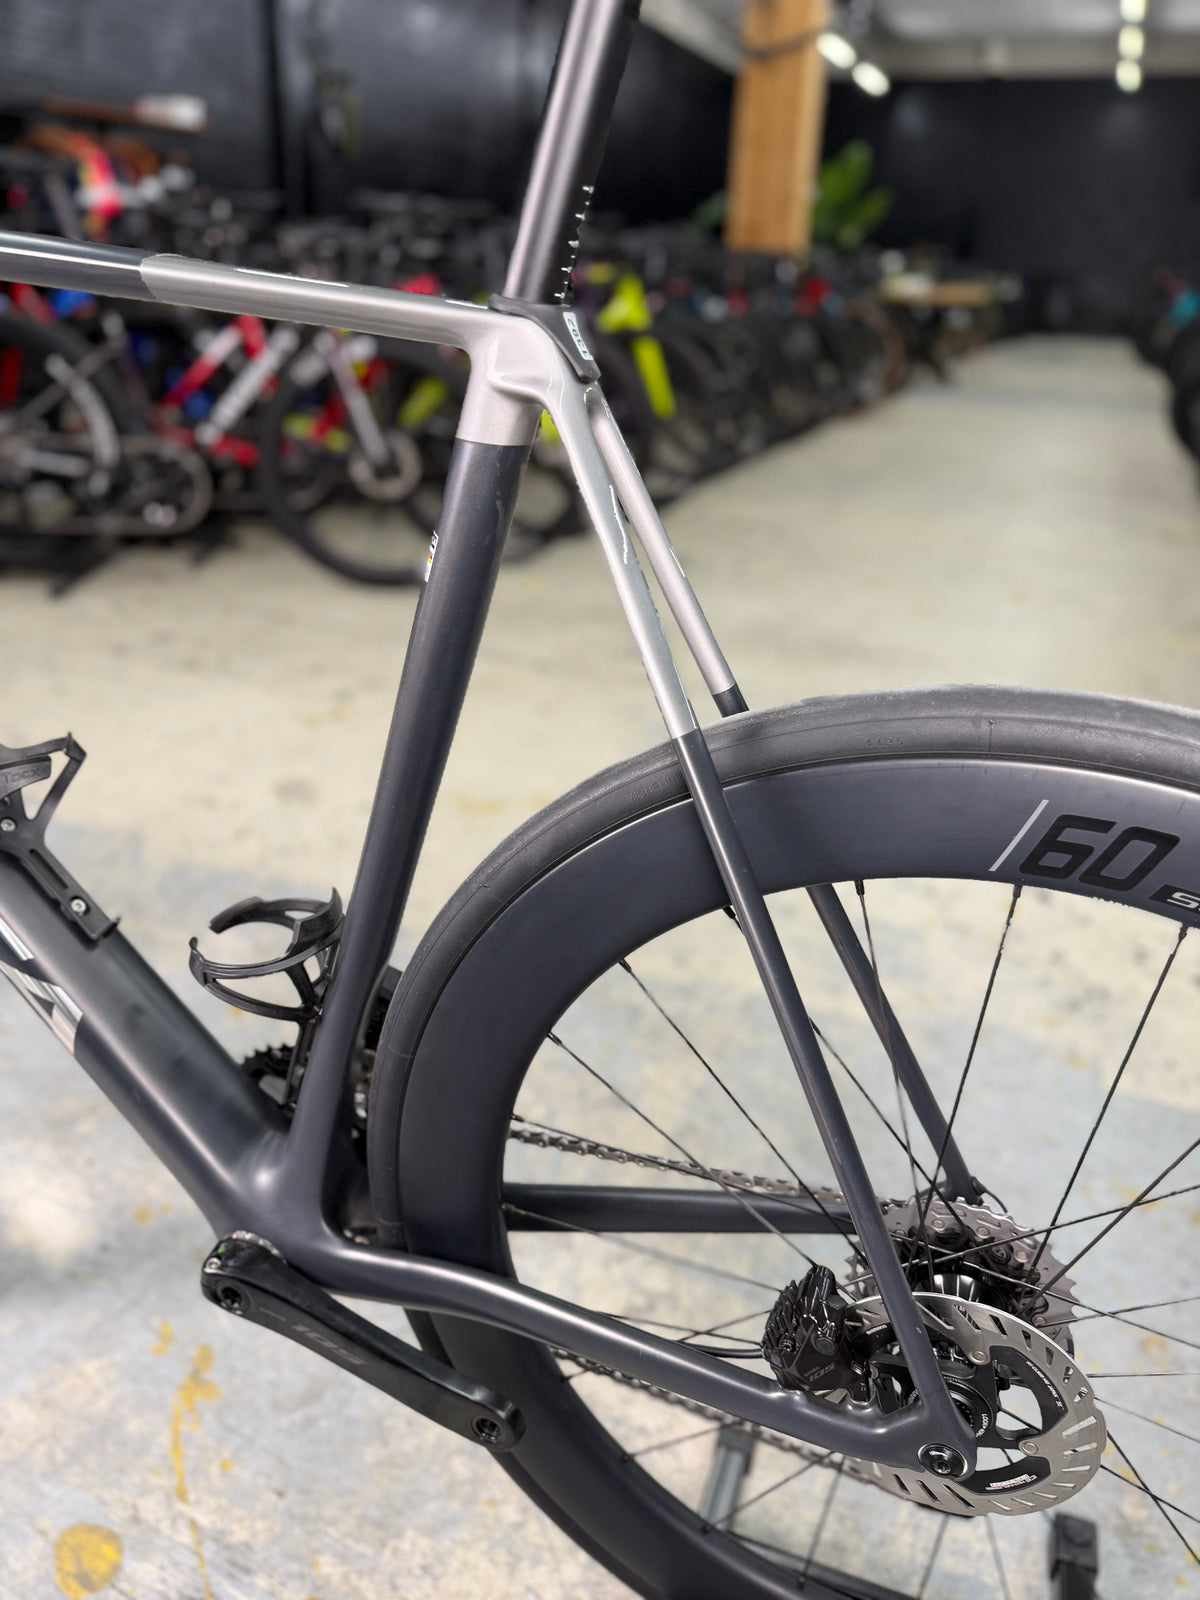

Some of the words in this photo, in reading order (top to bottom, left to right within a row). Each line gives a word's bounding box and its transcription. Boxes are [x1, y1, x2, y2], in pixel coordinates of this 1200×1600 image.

[1019, 814, 1131, 892] 60
[1167, 891, 1200, 911] S
[292, 1324, 368, 1367] 105
